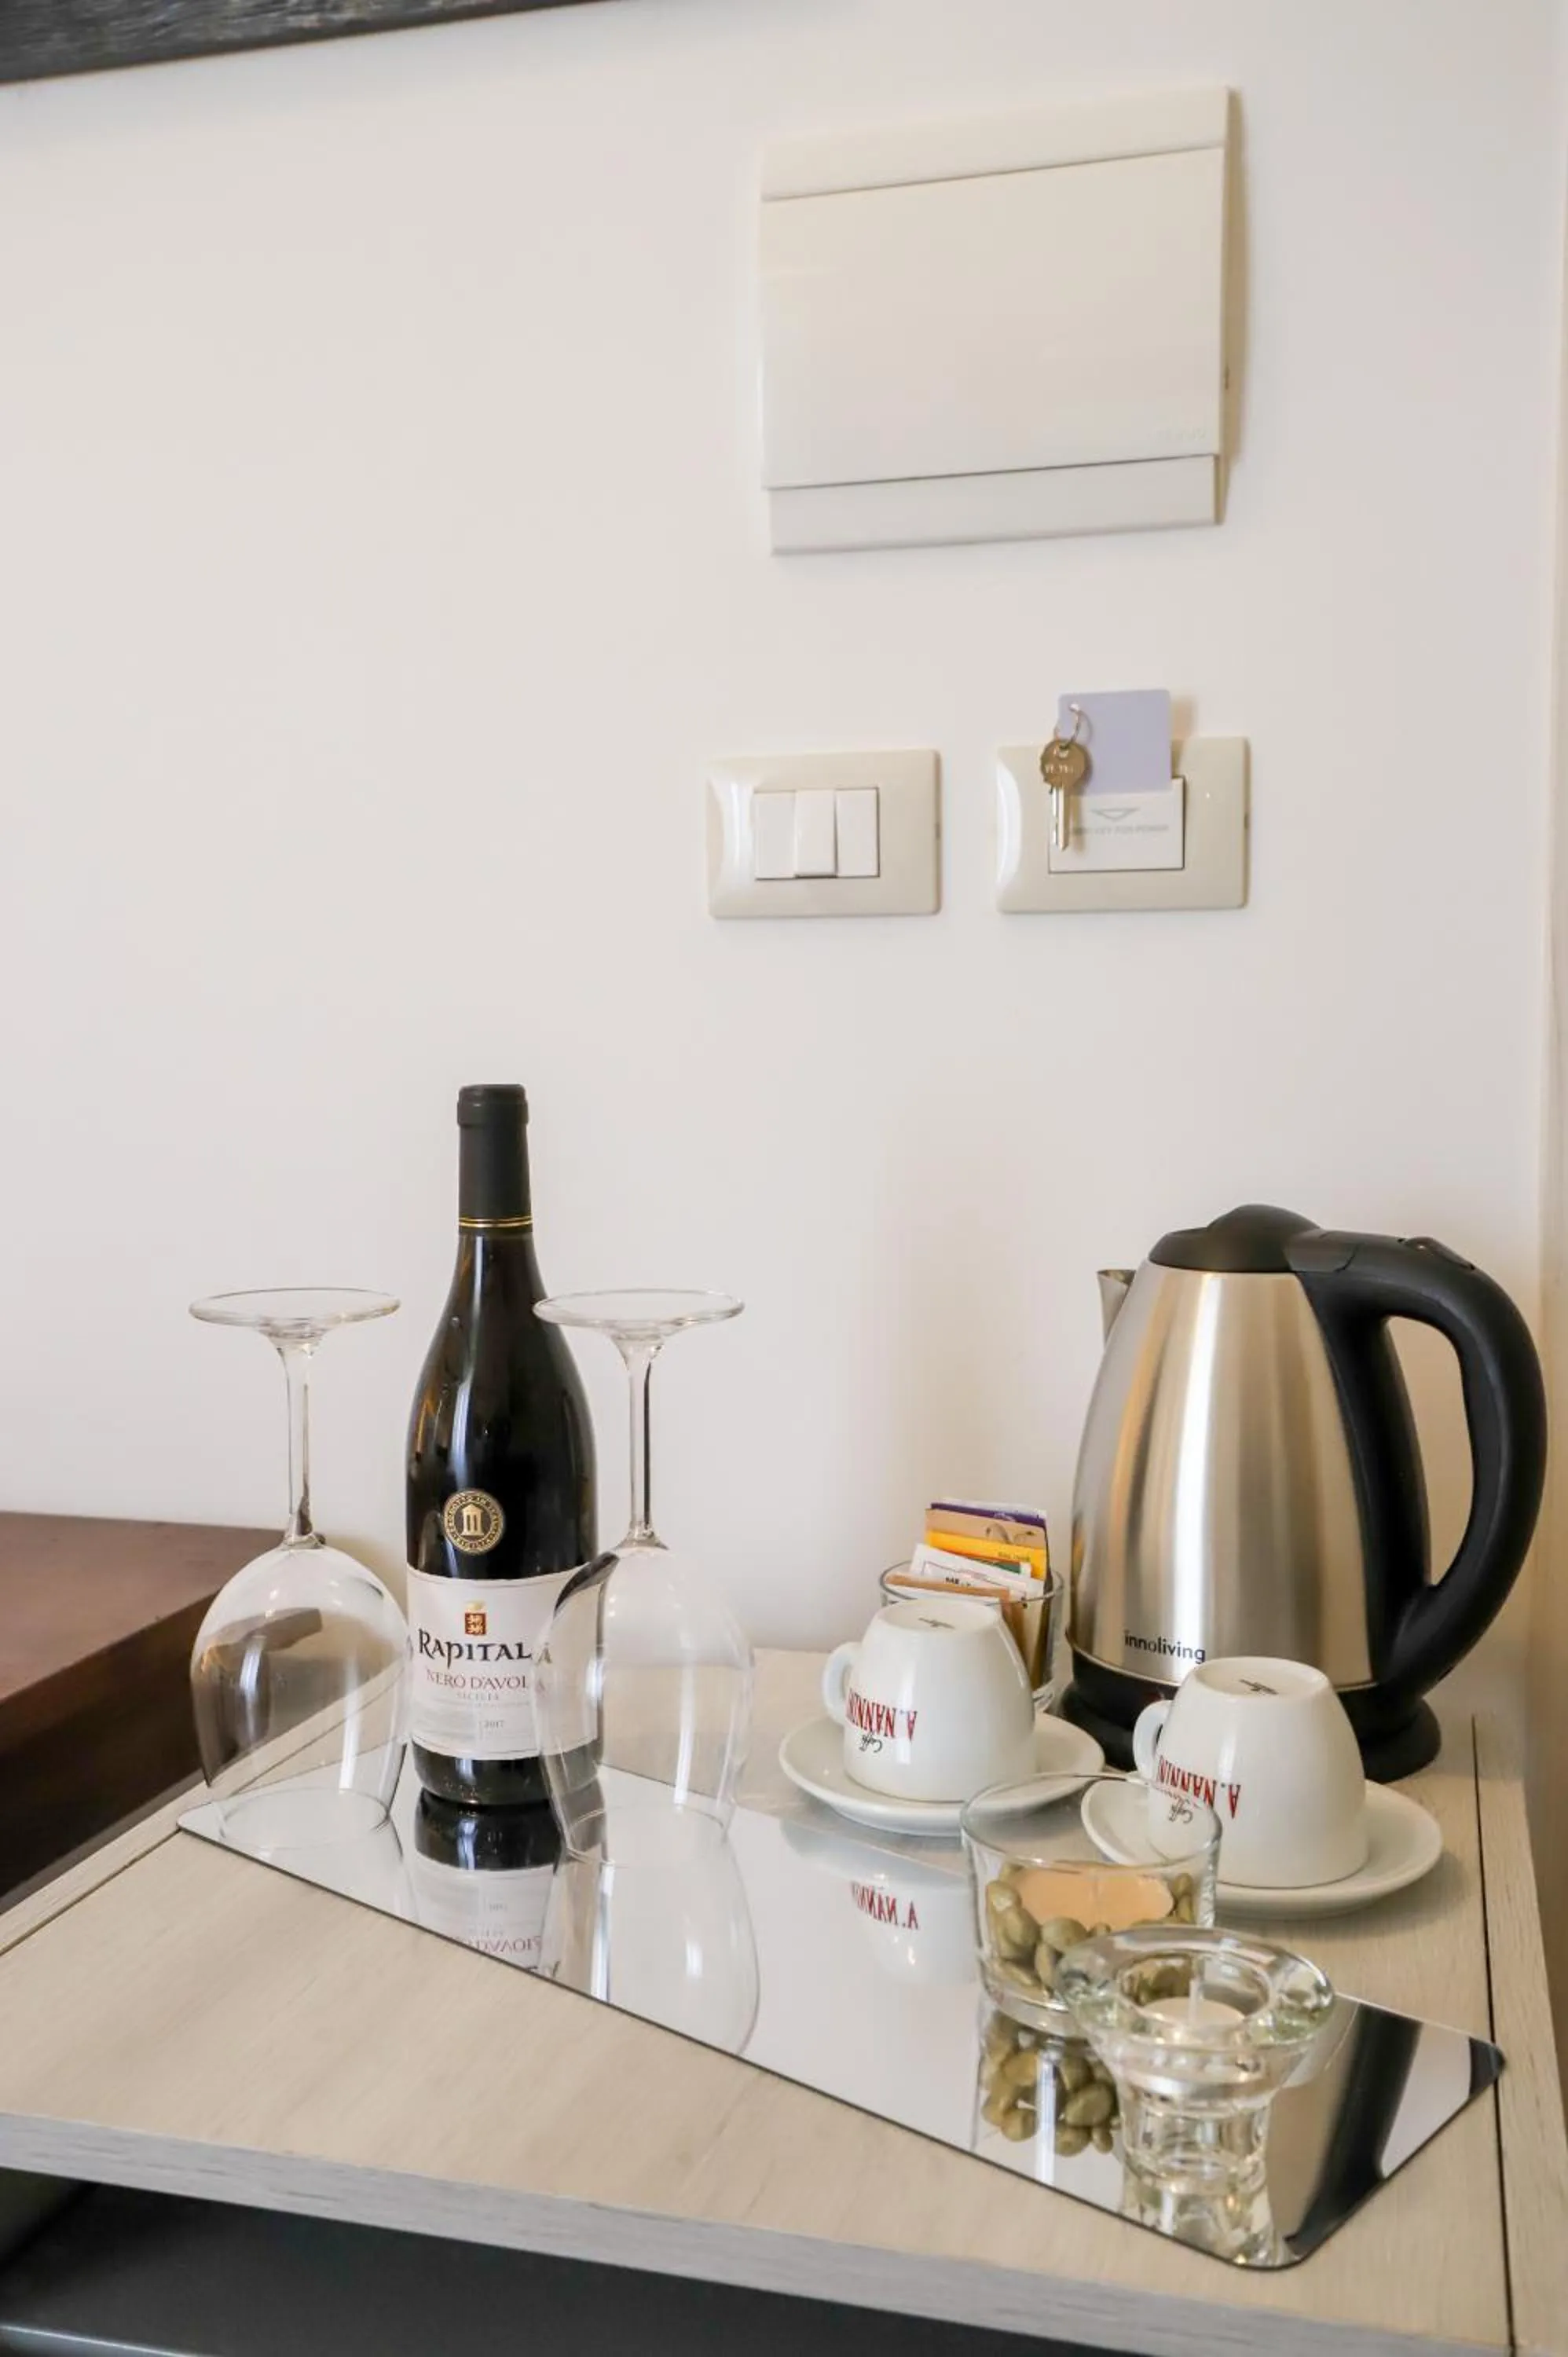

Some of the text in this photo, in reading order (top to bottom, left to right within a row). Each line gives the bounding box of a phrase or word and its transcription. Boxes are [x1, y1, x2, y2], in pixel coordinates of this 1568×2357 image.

[1124, 1629, 1206, 1665] innoliving
[427, 1667, 467, 1688] NERO
[1220, 1783, 1241, 1820] A.
